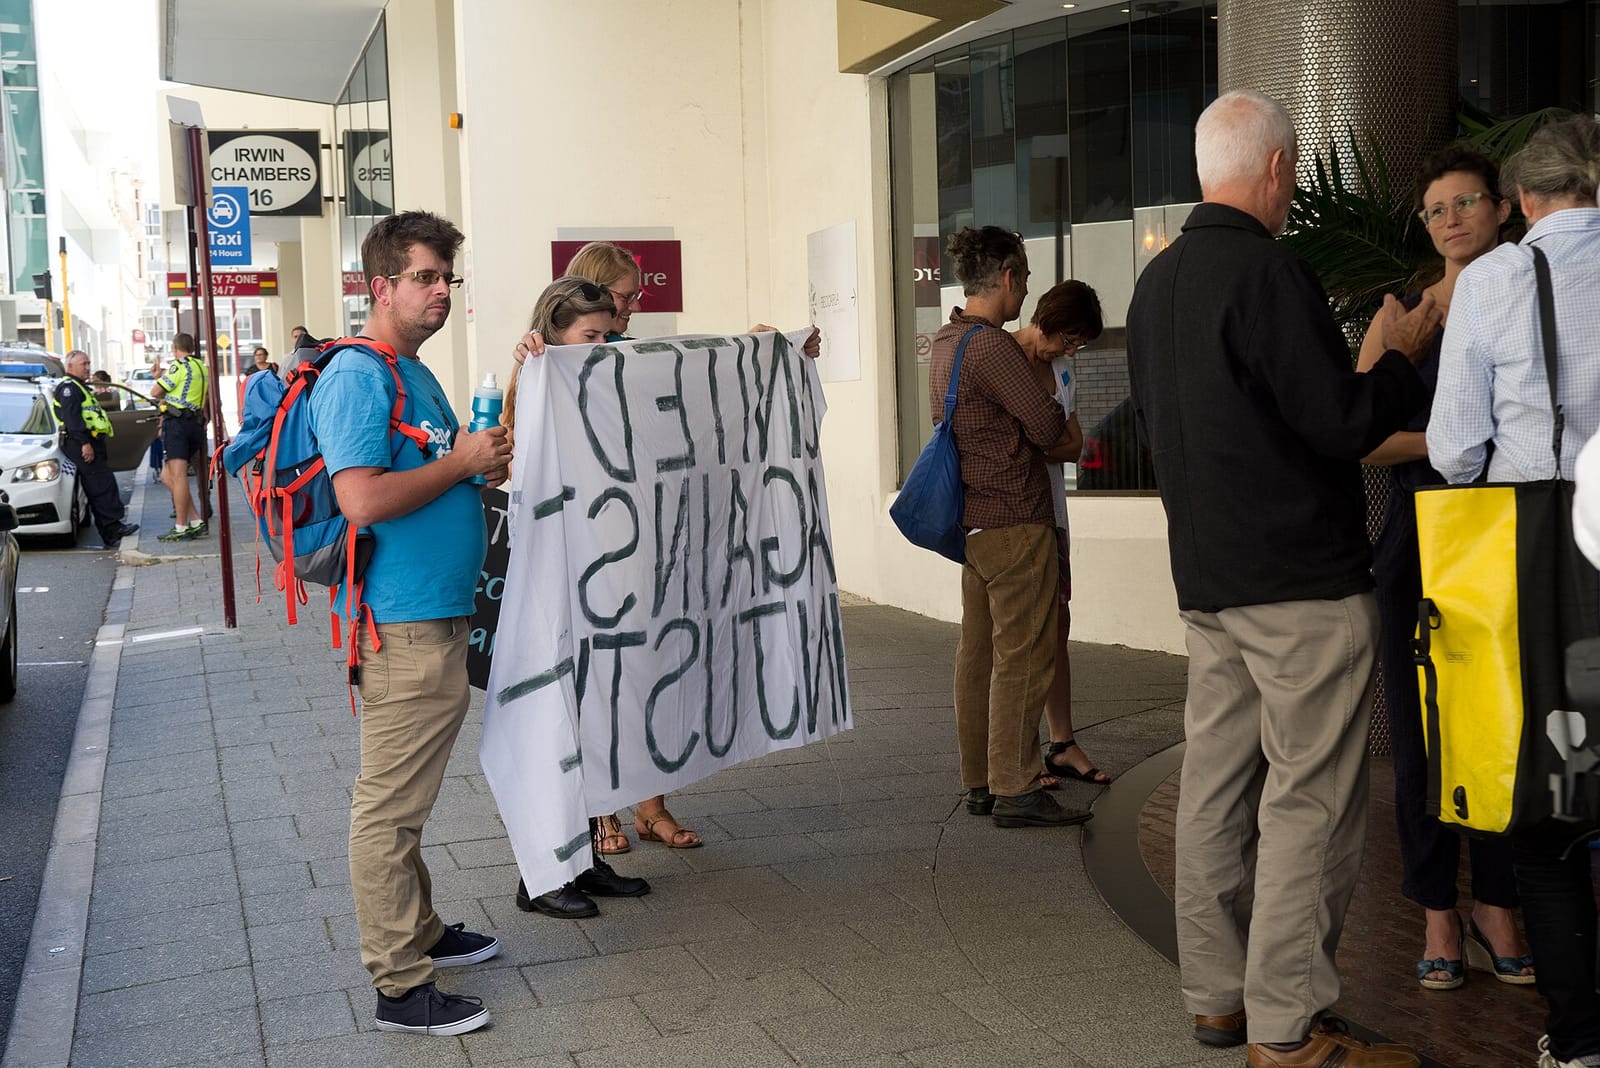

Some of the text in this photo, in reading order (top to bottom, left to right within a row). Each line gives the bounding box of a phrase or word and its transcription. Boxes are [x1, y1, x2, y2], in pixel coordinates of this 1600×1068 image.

[234, 148, 285, 162] IRWIN
[211, 167, 311, 182] CHAMBERS
[249, 188, 273, 206] 16
[208, 231, 242, 246] Taxi
[218, 249, 243, 257] Hours
[225, 274, 258, 285] 7-ONE
[420, 420, 451, 449] Say
